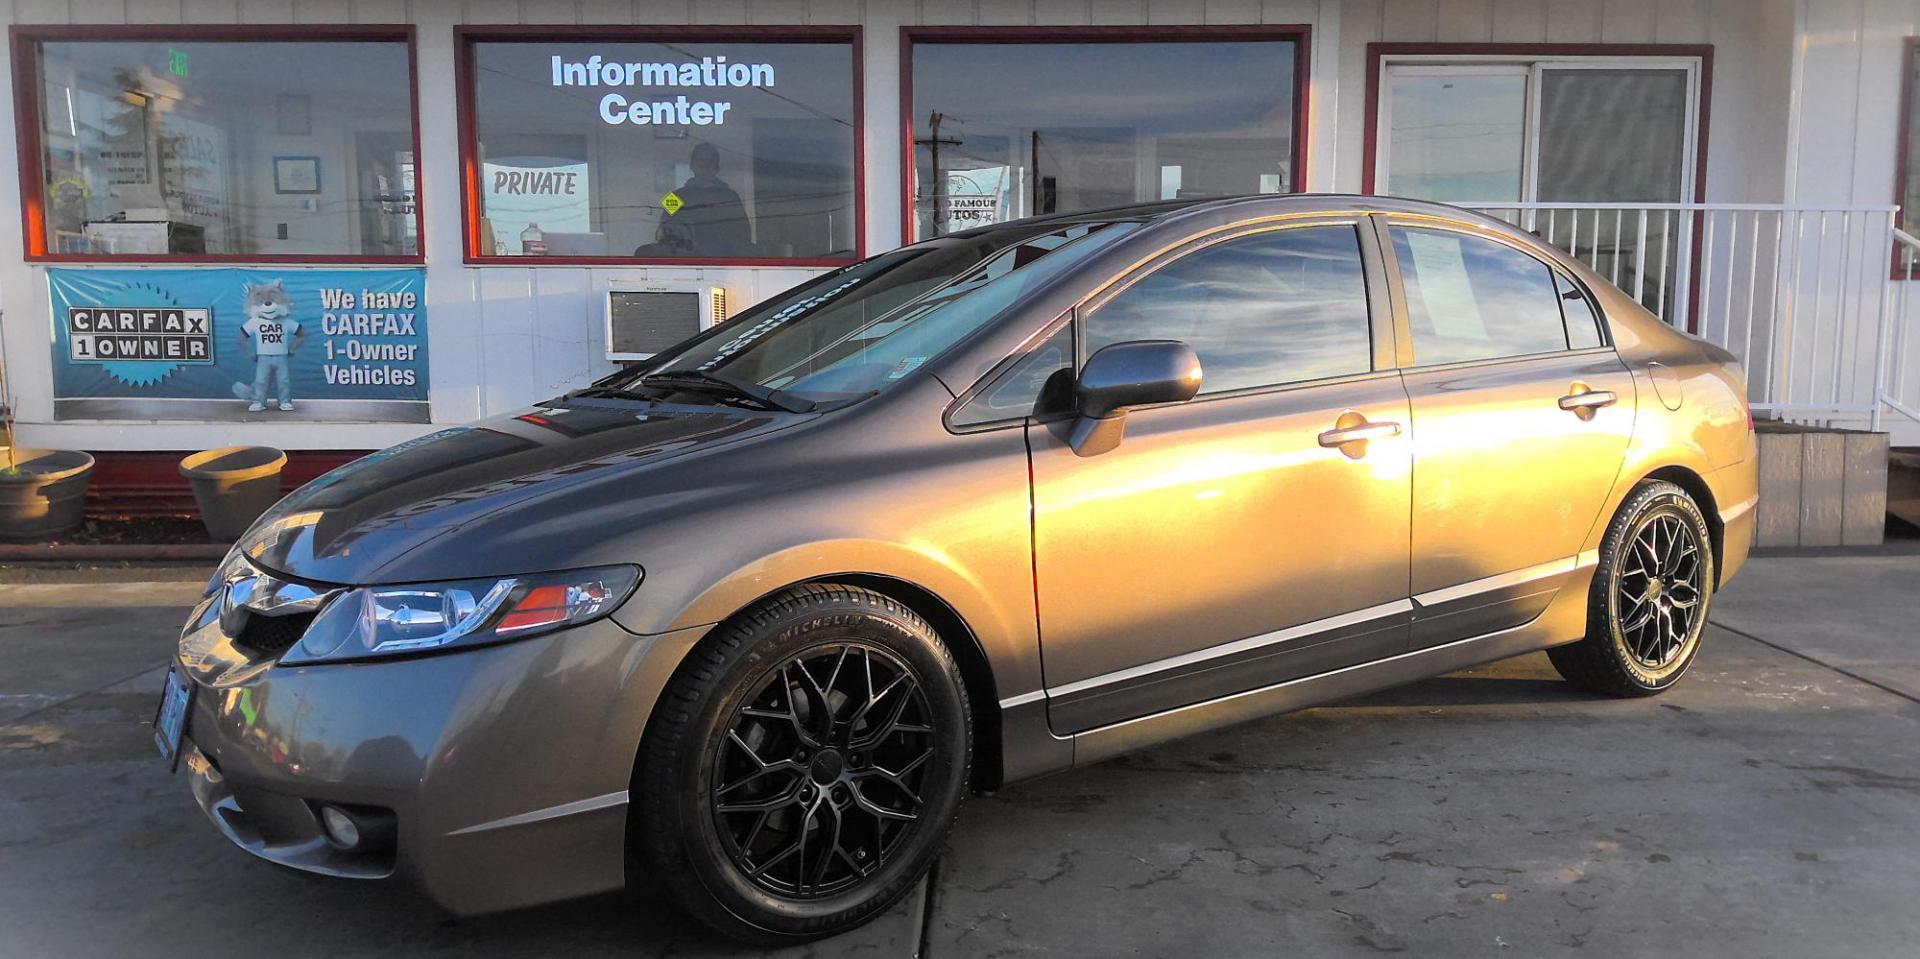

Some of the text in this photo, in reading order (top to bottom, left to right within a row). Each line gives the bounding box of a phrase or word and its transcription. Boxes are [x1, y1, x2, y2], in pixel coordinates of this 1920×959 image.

[552, 56, 774, 87] Information
[599, 93, 731, 125] Center
[494, 171, 577, 195] PRIVATE
[320, 288, 416, 310] We have
[73, 312, 205, 333] CARFAX
[259, 323, 283, 334] CAR
[322, 313, 416, 335] CARFAX
[261, 334, 283, 343] FOX
[323, 339, 417, 361] 1-Owner
[323, 364, 416, 385] Vehicles
